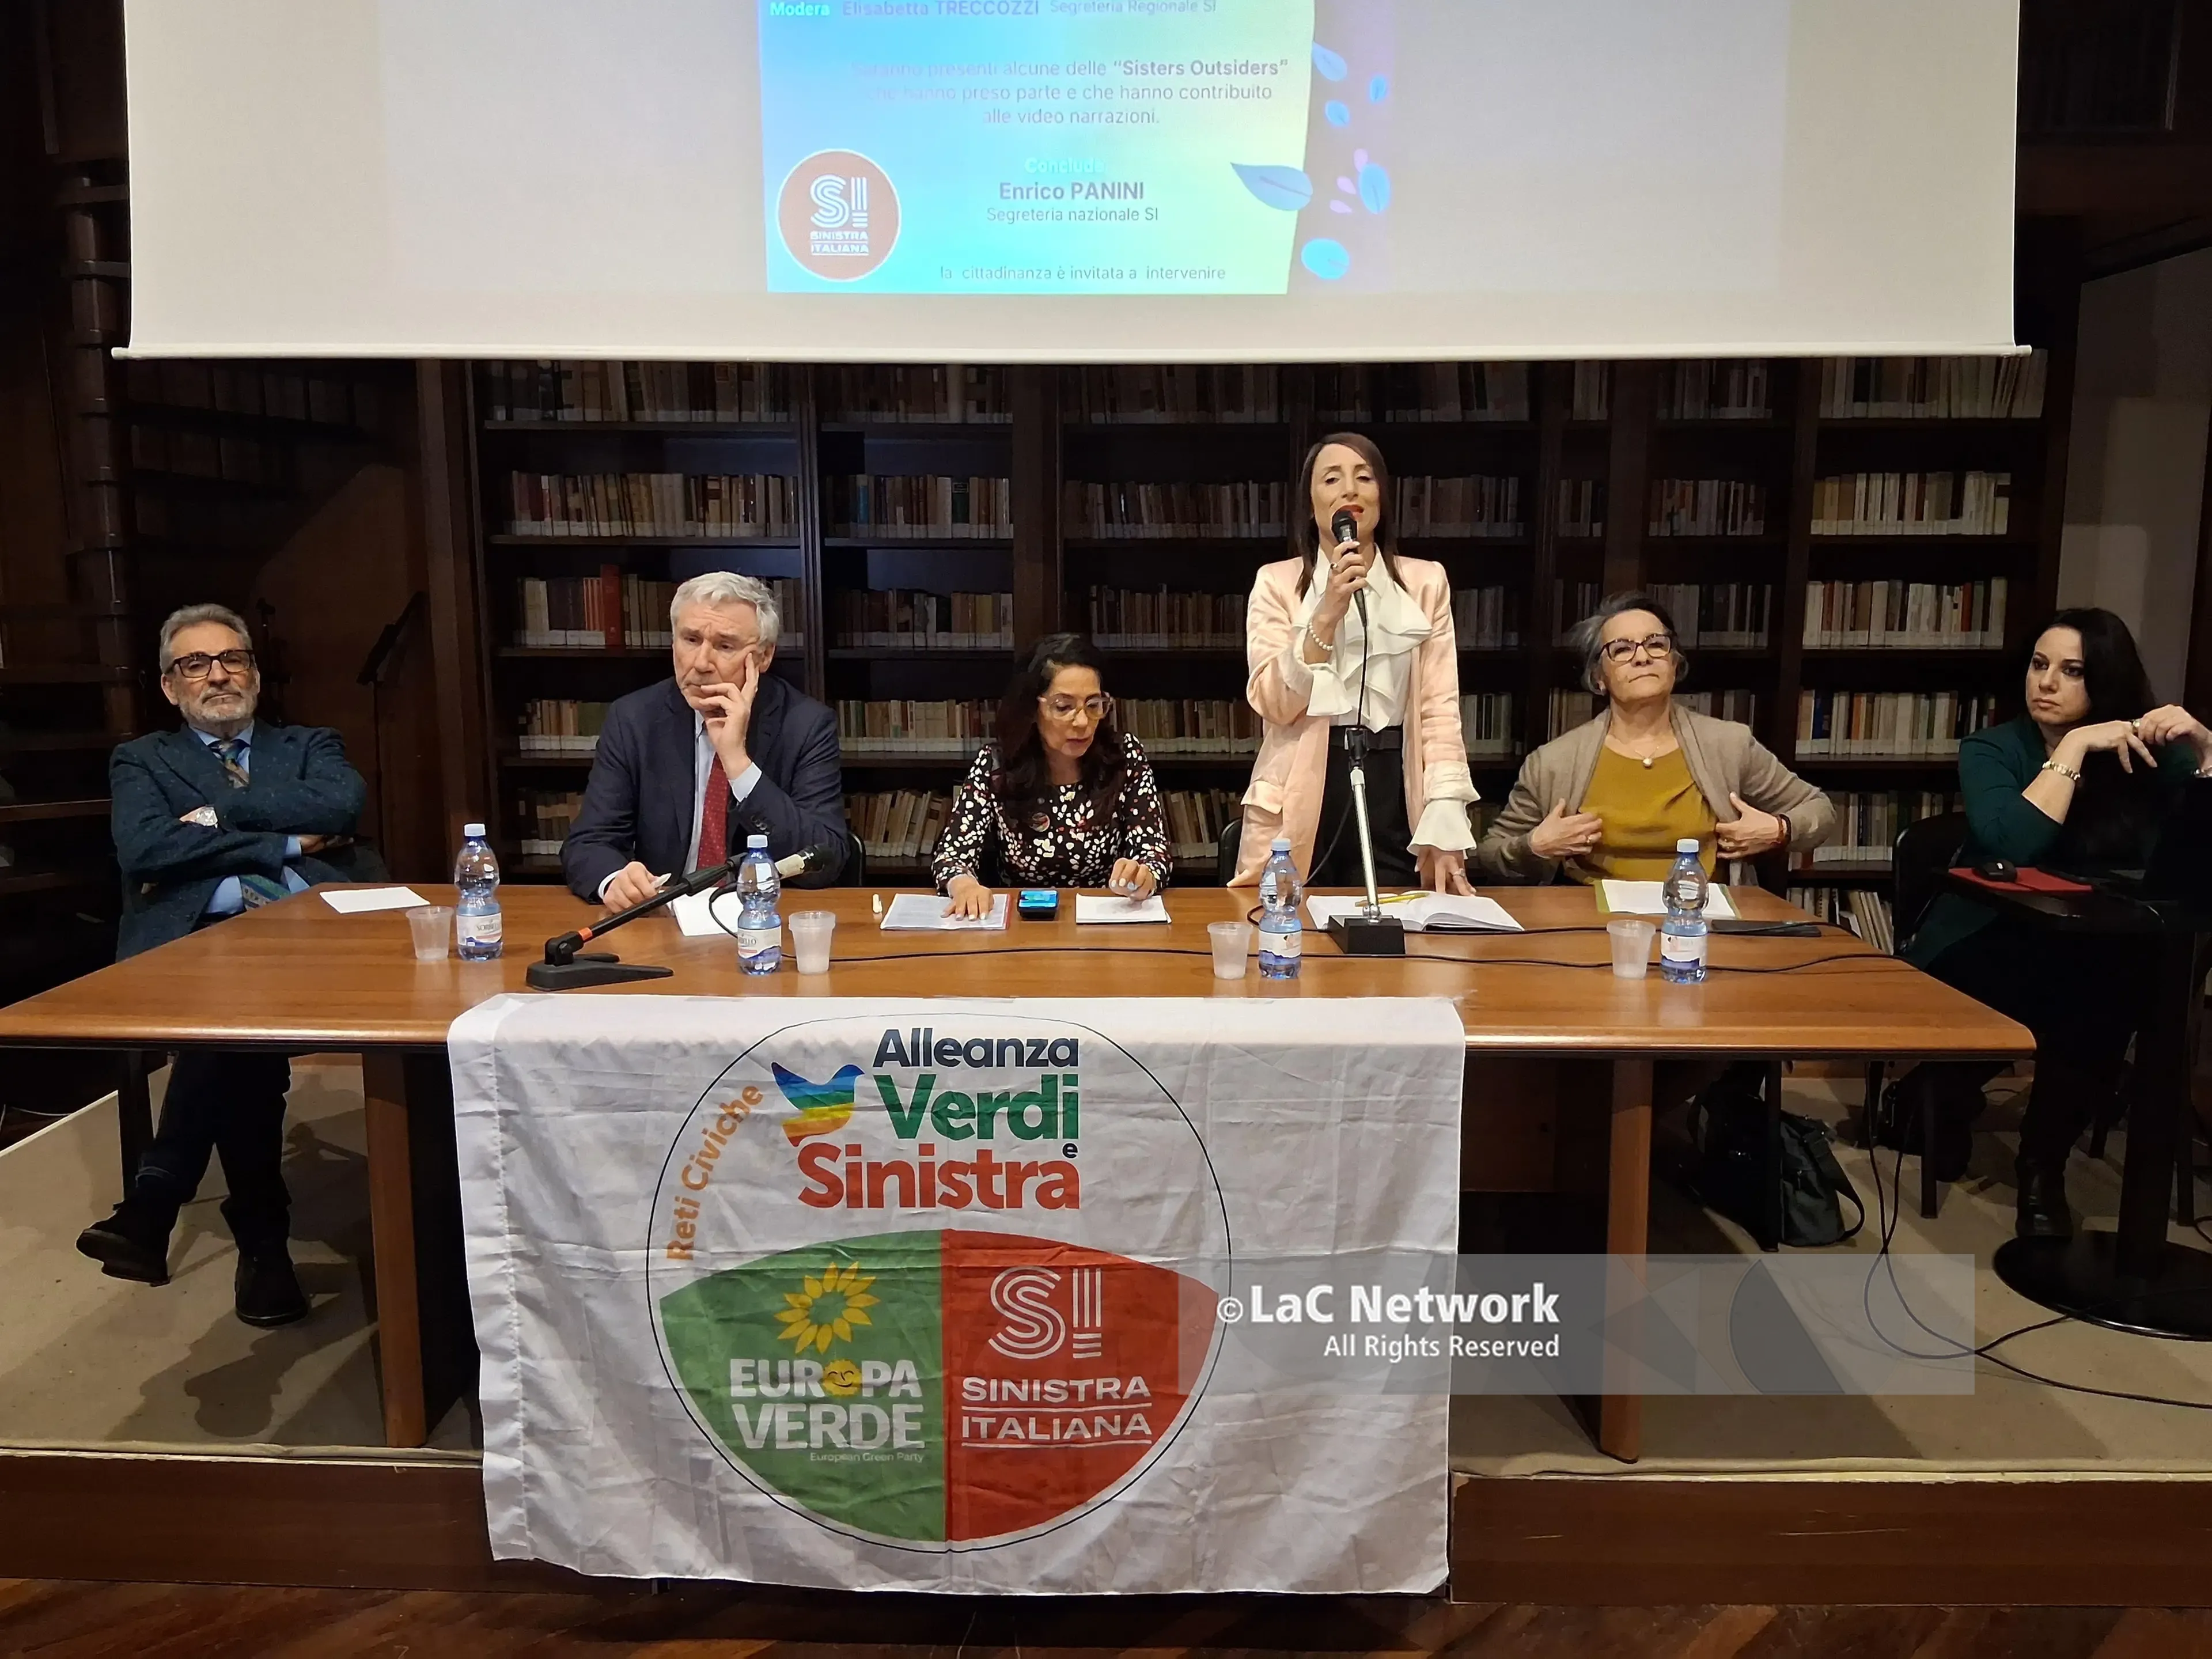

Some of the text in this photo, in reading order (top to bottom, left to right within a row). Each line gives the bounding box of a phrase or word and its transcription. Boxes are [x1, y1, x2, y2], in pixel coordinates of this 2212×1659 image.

[770, 0, 1217, 16] Modera Elisabetta TRECCOZZI Segreteria Regionale SI
[928, 62, 997, 79] presenti
[1003, 61, 1060, 76] alcune
[1066, 60, 1106, 75] delle
[903, 85, 956, 100] hanno
[962, 89, 1010, 102] preso
[1017, 86, 1060, 103] parte
[1067, 89, 1076, 99] e
[1082, 85, 1113, 100] che
[1120, 85, 1173, 100] hanno
[1179, 84, 1272, 100] contribuito
[983, 109, 1160, 124] alle video narrazioni.
[999, 182, 1144, 200] Enrico PANINI
[987, 207, 1158, 224] Segreteria nazionale SI
[810, 230, 868, 240] SINISTRA
[811, 244, 869, 253] ITALIANA
[941, 266, 1226, 279] la cittadinanza è invitata a intervenire
[873, 1028, 1078, 1068] Alleanza
[873, 1074, 1078, 1159] Verdi e
[666, 1085, 763, 1260] Reti Civiche
[797, 1142, 1080, 1210] Sinistra
[730, 1358, 923, 1397] EUROPA
[961, 1374, 1152, 1402] SINISTRA
[732, 1403, 925, 1450] VERDE
[961, 1412, 1152, 1439] ITALIANA
[810, 1452, 924, 1463] European Green Party
